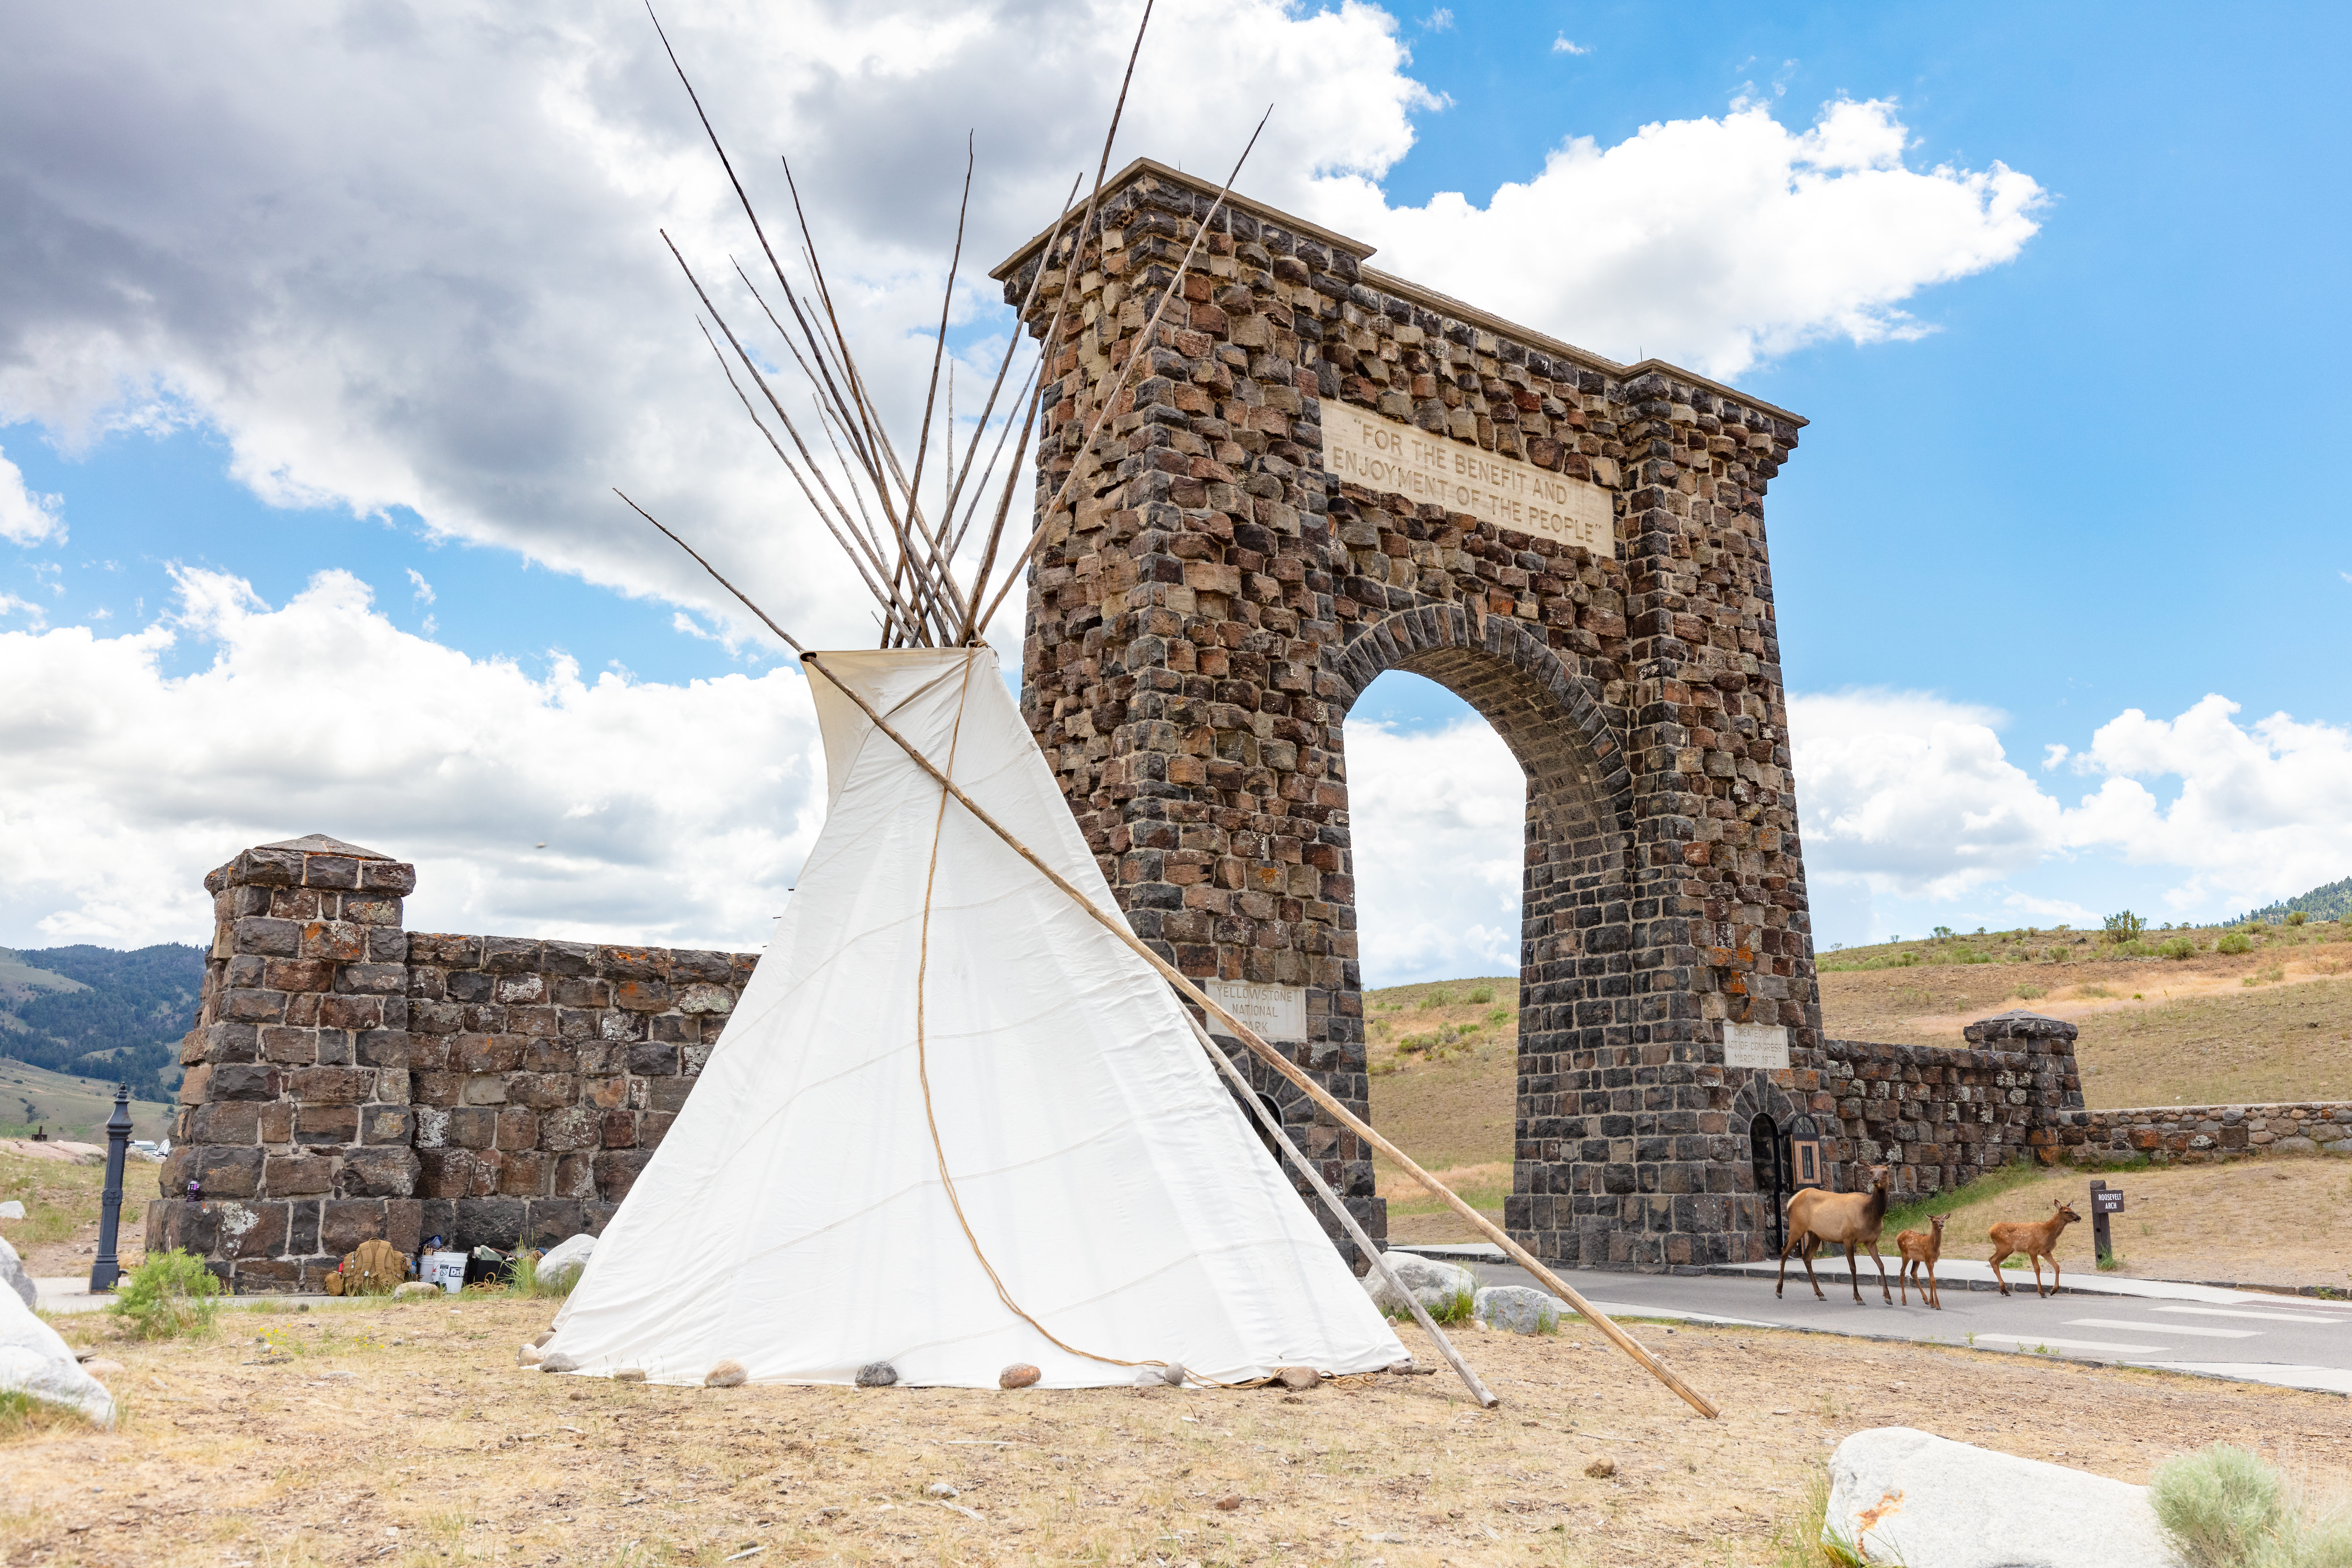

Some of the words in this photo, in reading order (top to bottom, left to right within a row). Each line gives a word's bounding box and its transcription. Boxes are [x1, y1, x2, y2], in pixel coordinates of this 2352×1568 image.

[1412, 439, 1446, 469] THE
[1455, 453, 1527, 493] BENEFIT
[1533, 479, 1567, 505] AND
[1333, 446, 1448, 500] ENJOYMENT
[1456, 486, 1480, 509] OF
[1489, 494, 1522, 522] THE
[1217, 986, 1292, 1002] YELLOWSTONE
[1232, 1004, 1278, 1018] NATIONAL
[1242, 1021, 1268, 1033] PARK
[1735, 1028, 1762, 1038] CREATED
[1766, 1030, 1774, 1039] BY
[1727, 1040, 1738, 1049] ACT
[1741, 1041, 1748, 1050] OF
[1751, 1042, 1782, 1052] CONGRESS
[1735, 1054, 1755, 1063] MARCH
